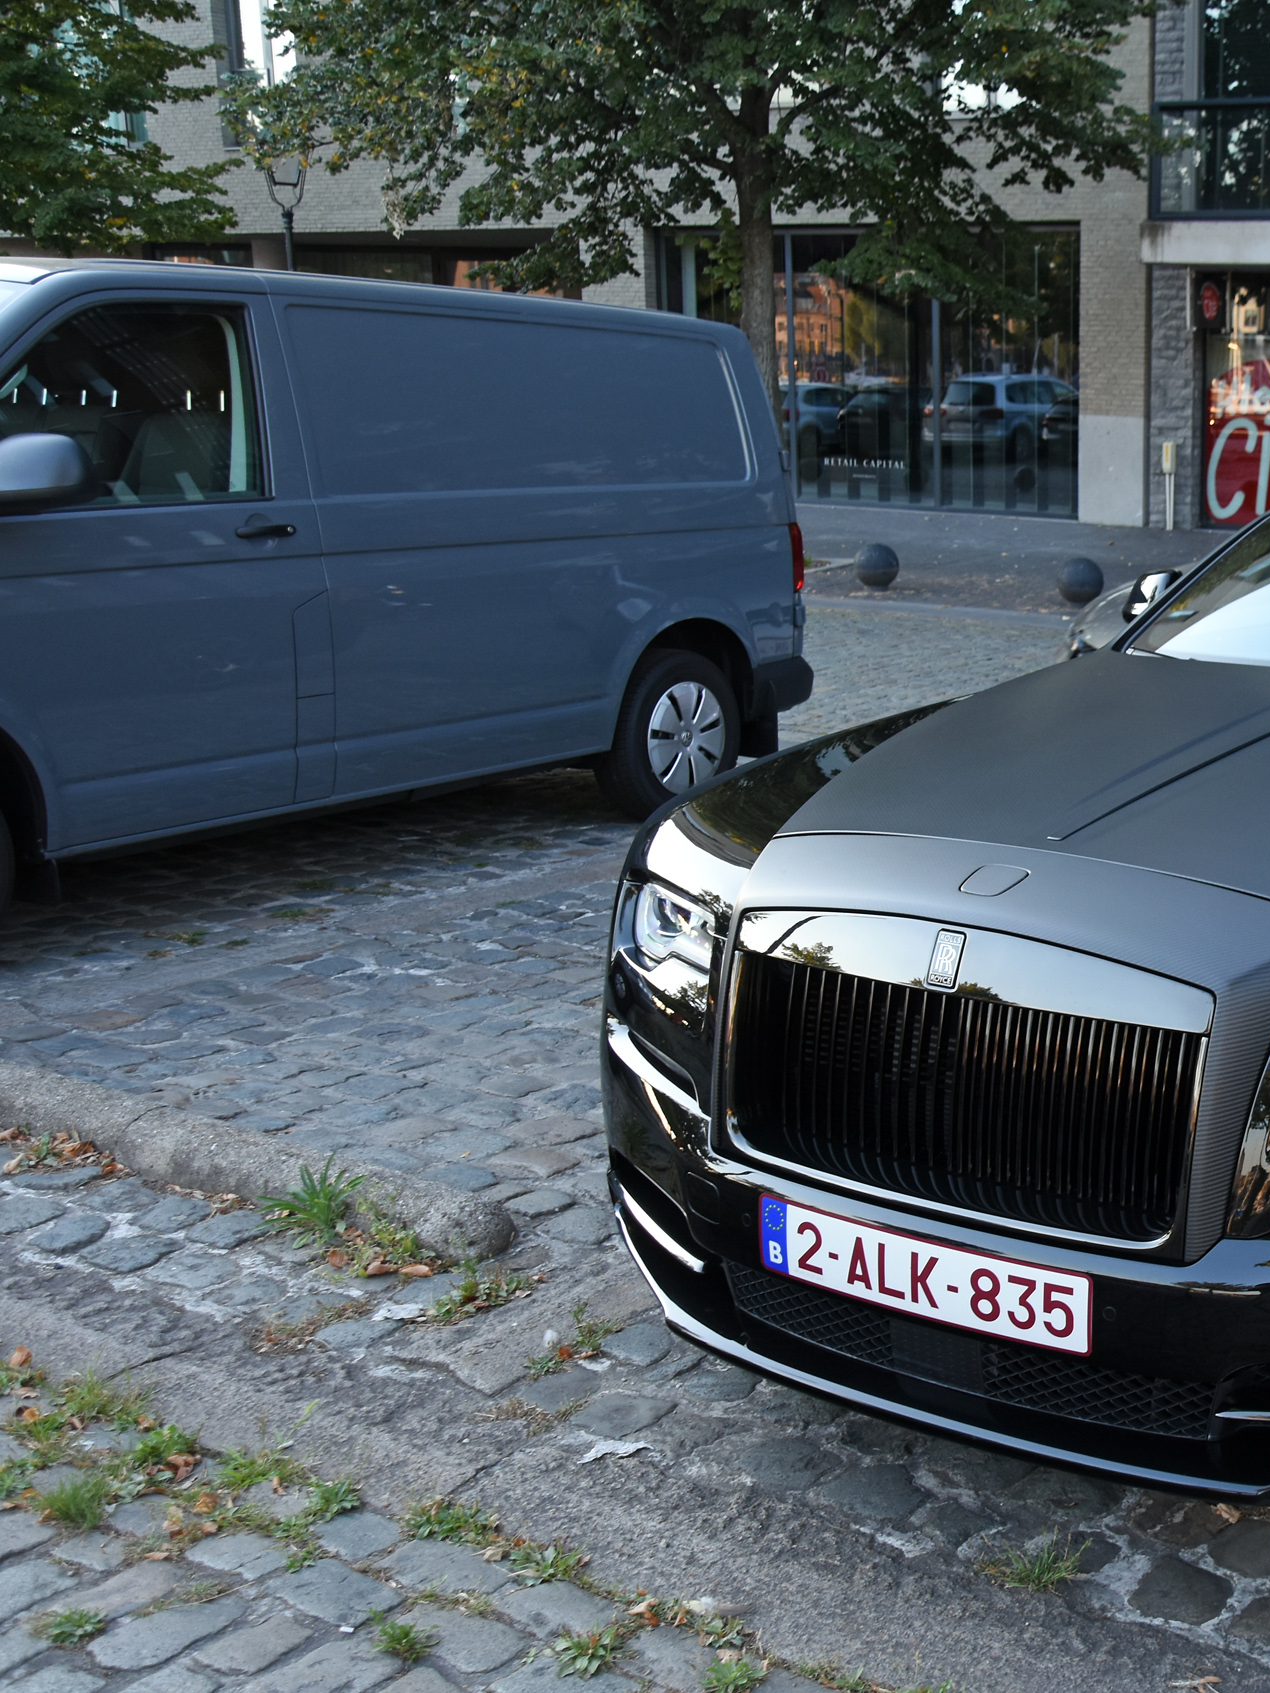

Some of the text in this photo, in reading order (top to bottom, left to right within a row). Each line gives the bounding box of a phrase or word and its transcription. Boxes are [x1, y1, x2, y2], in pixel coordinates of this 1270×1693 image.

[824, 457, 906, 470] RETAIL CAPITAL
[940, 933, 962, 944] ROLLS
[930, 974, 952, 985] ROYCE
[768, 1240, 783, 1264] B
[796, 1221, 1074, 1338] 2-ALK-835
